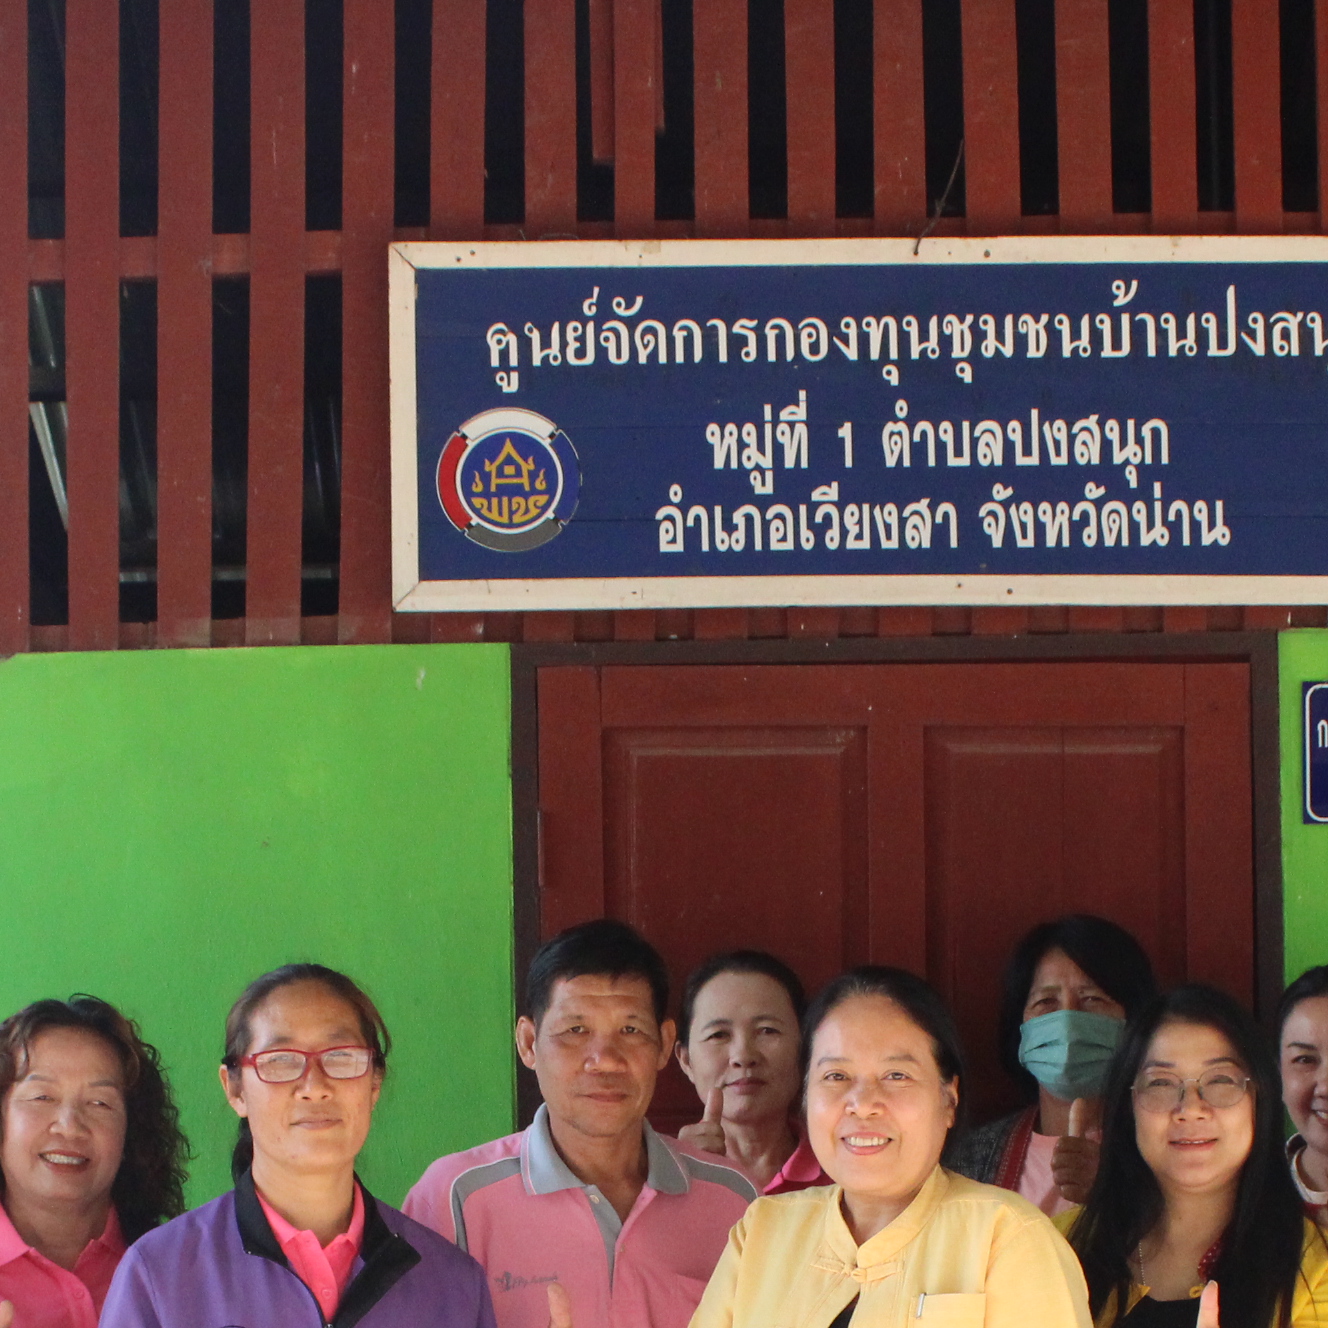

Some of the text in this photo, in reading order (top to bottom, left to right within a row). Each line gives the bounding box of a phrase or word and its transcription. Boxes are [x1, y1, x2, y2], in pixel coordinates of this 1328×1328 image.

[705, 390, 1171, 495] หมู่ที่ 1 ตำบลปงสนุก
[655, 481, 1232, 553] อำเภอเวียงสา จังหวัดน่าน
